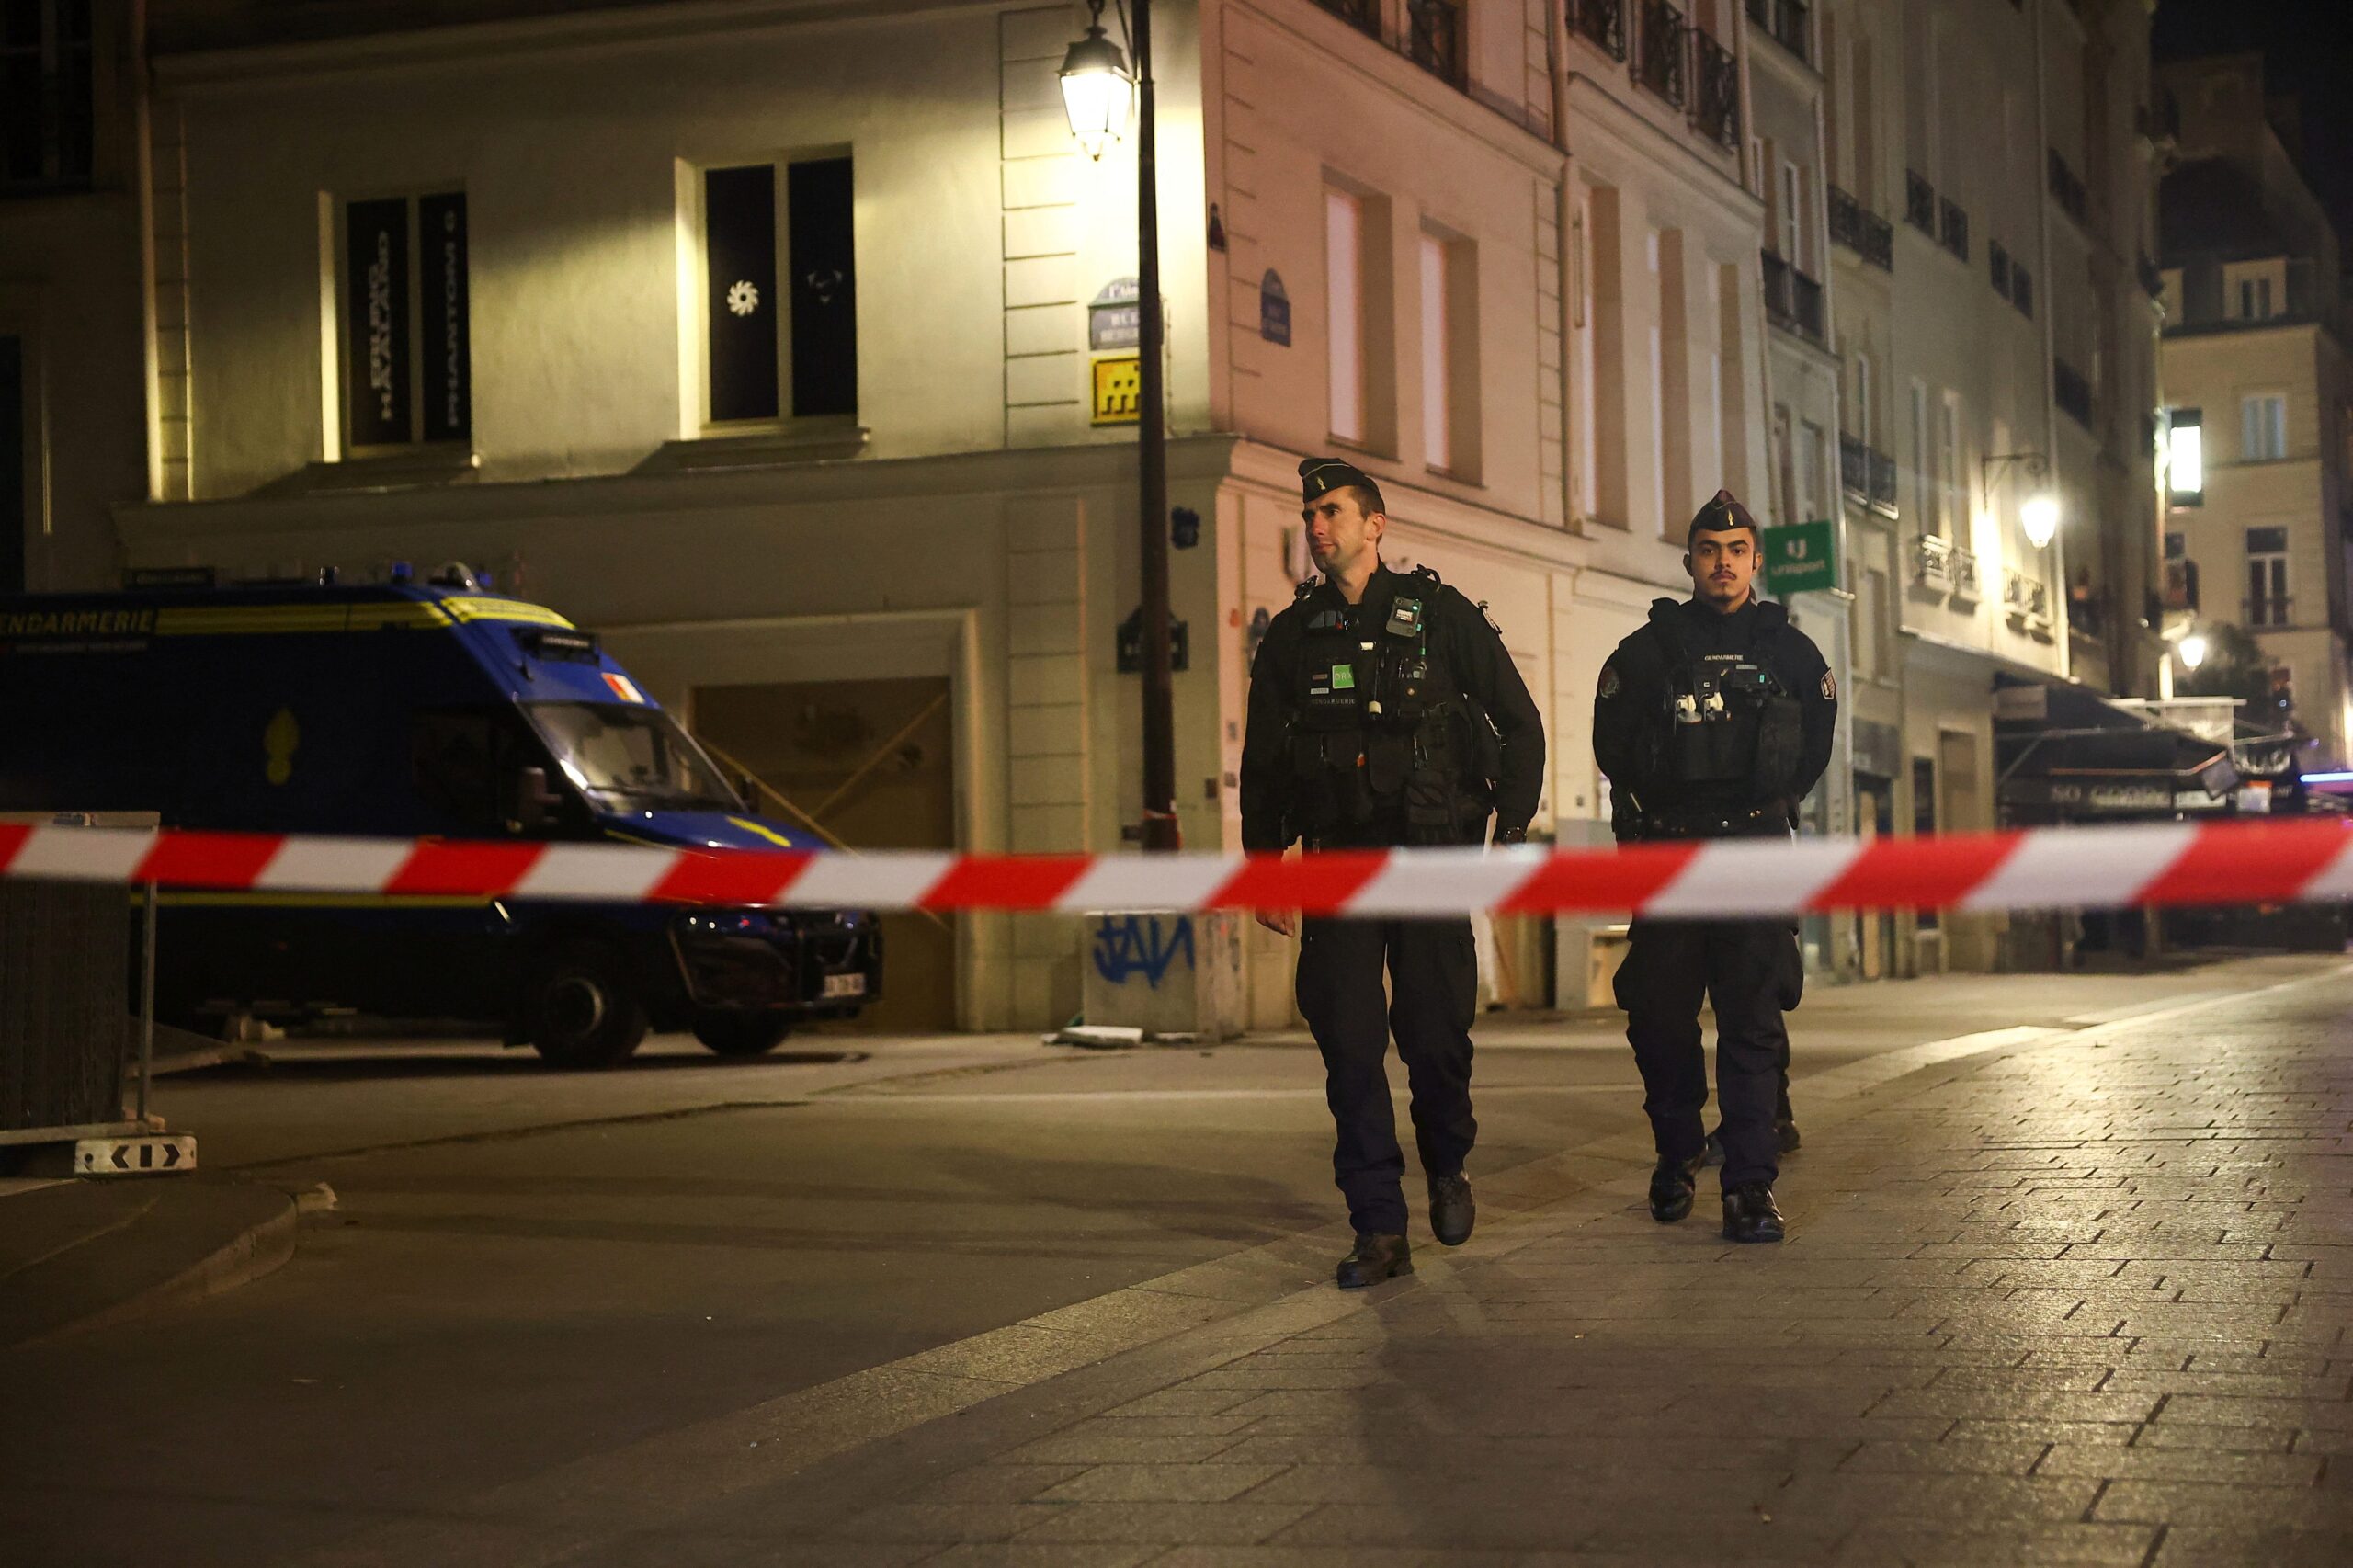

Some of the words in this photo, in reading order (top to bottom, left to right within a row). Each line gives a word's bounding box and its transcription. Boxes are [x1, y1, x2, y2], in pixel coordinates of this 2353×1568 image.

[378, 230, 392, 420] HAALAND
[446, 241, 459, 427] PHANTOM
[0, 608, 154, 634] ENDARMERIE
